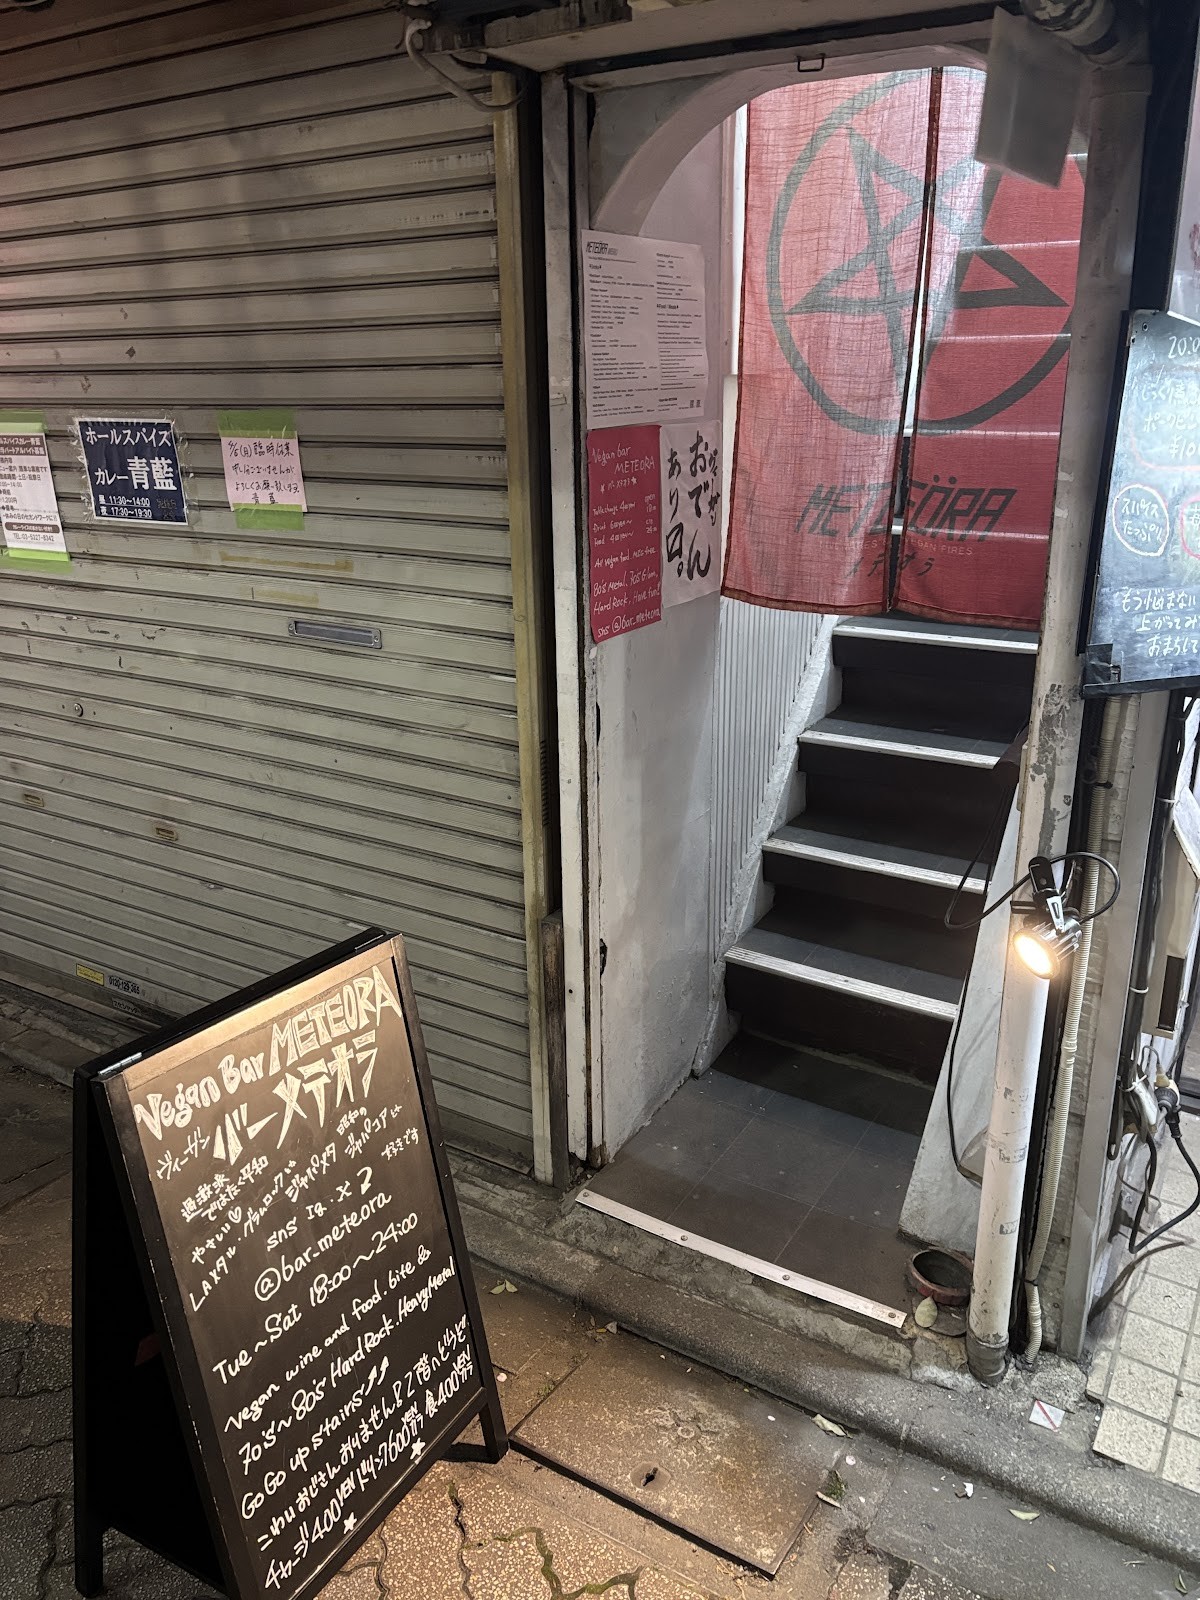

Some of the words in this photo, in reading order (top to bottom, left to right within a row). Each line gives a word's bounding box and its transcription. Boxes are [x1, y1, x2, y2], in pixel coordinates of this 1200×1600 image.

[85, 427, 172, 448] ホールスパイス
[592, 447, 616, 466] Vegan
[617, 442, 632, 458] bar
[94, 456, 177, 490] カレー青藍
[614, 455, 656, 474] METEORA
[687, 430, 711, 581] おでん
[594, 596, 611, 616] Hard
[133, 1076, 221, 1141] Vegan
[218, 1053, 265, 1095] Bar
[269, 965, 402, 1077] METEORA
[156, 1126, 211, 1180] ヴィーガン
[212, 1029, 378, 1166] バーメテオラ
[380, 1127, 420, 1161] 好きです
[254, 1192, 392, 1302] @bar_meteora
[285, 1344, 322, 1381] wine
[324, 1313, 350, 1347] and
[388, 1261, 416, 1290] bite
[289, 1446, 311, 1473] up
